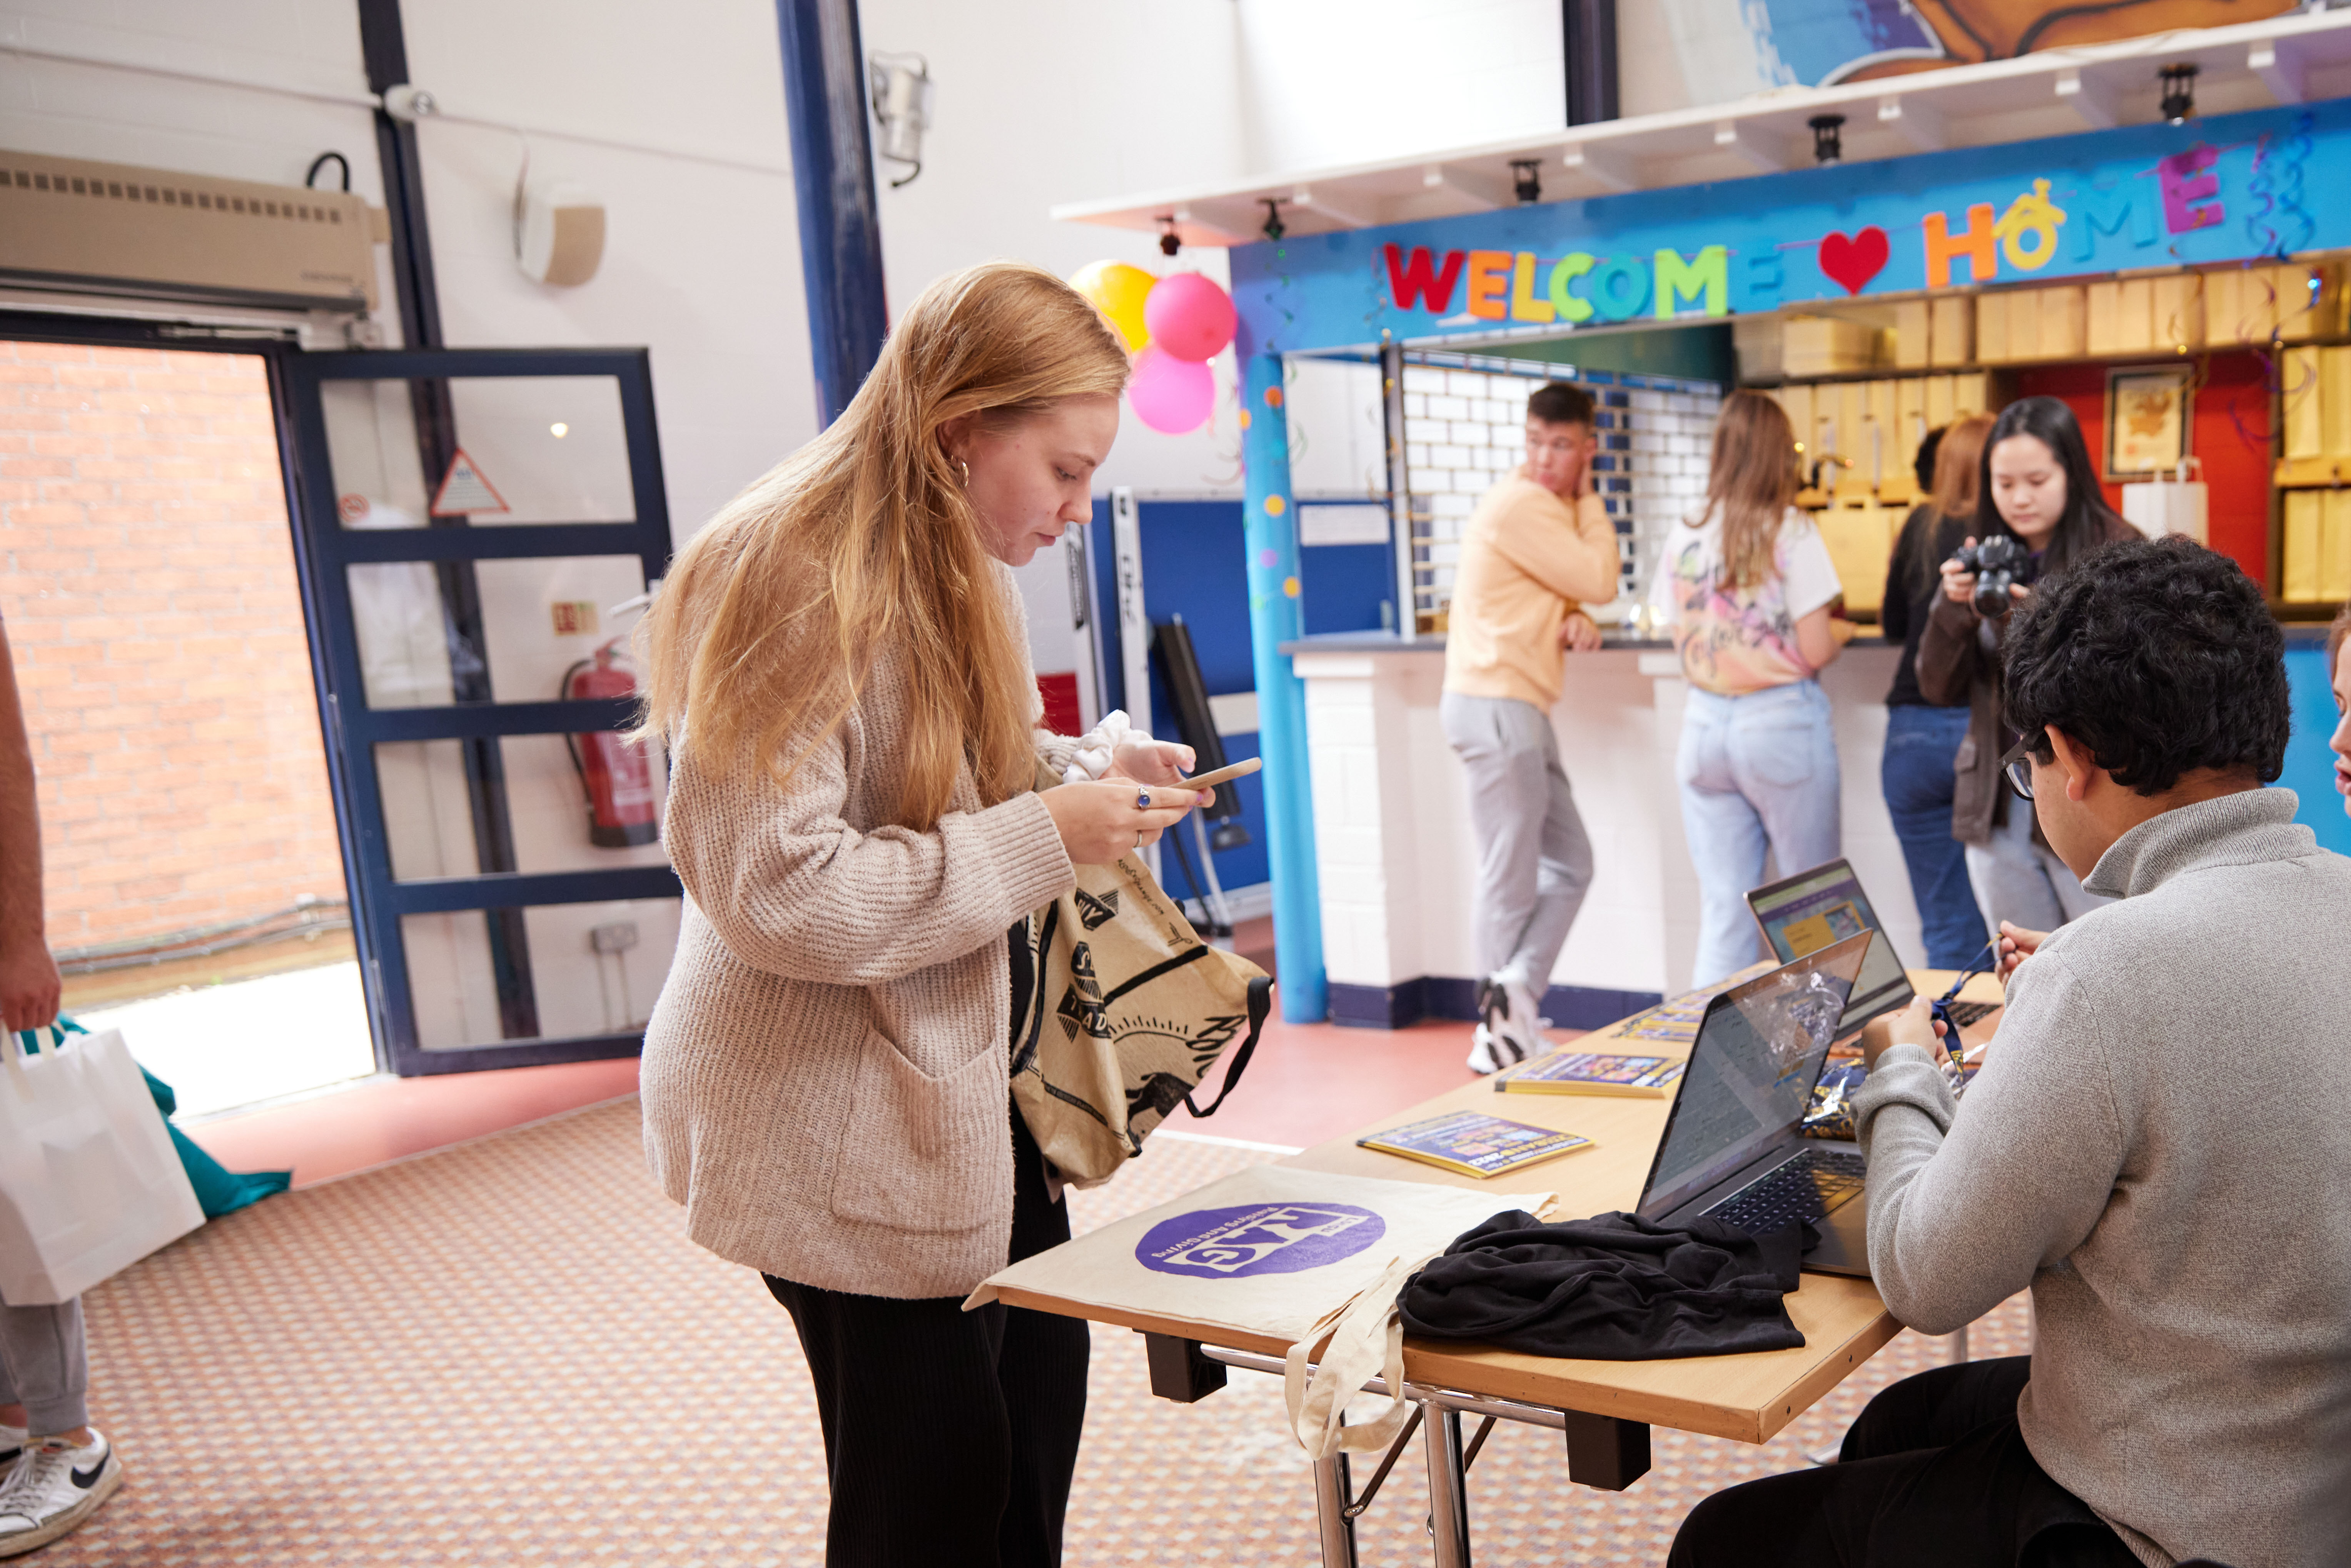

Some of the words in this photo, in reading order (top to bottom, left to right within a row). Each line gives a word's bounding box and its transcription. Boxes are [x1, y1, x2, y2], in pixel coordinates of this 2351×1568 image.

[1383, 237, 1783, 322] WELCOME
[1922, 145, 2225, 288] HOME
[1224, 1207, 1279, 1227] Raising
[1186, 1209, 1344, 1266] RAG
[1198, 1226, 1229, 1239] And
[1151, 1238, 1202, 1258] Giving
